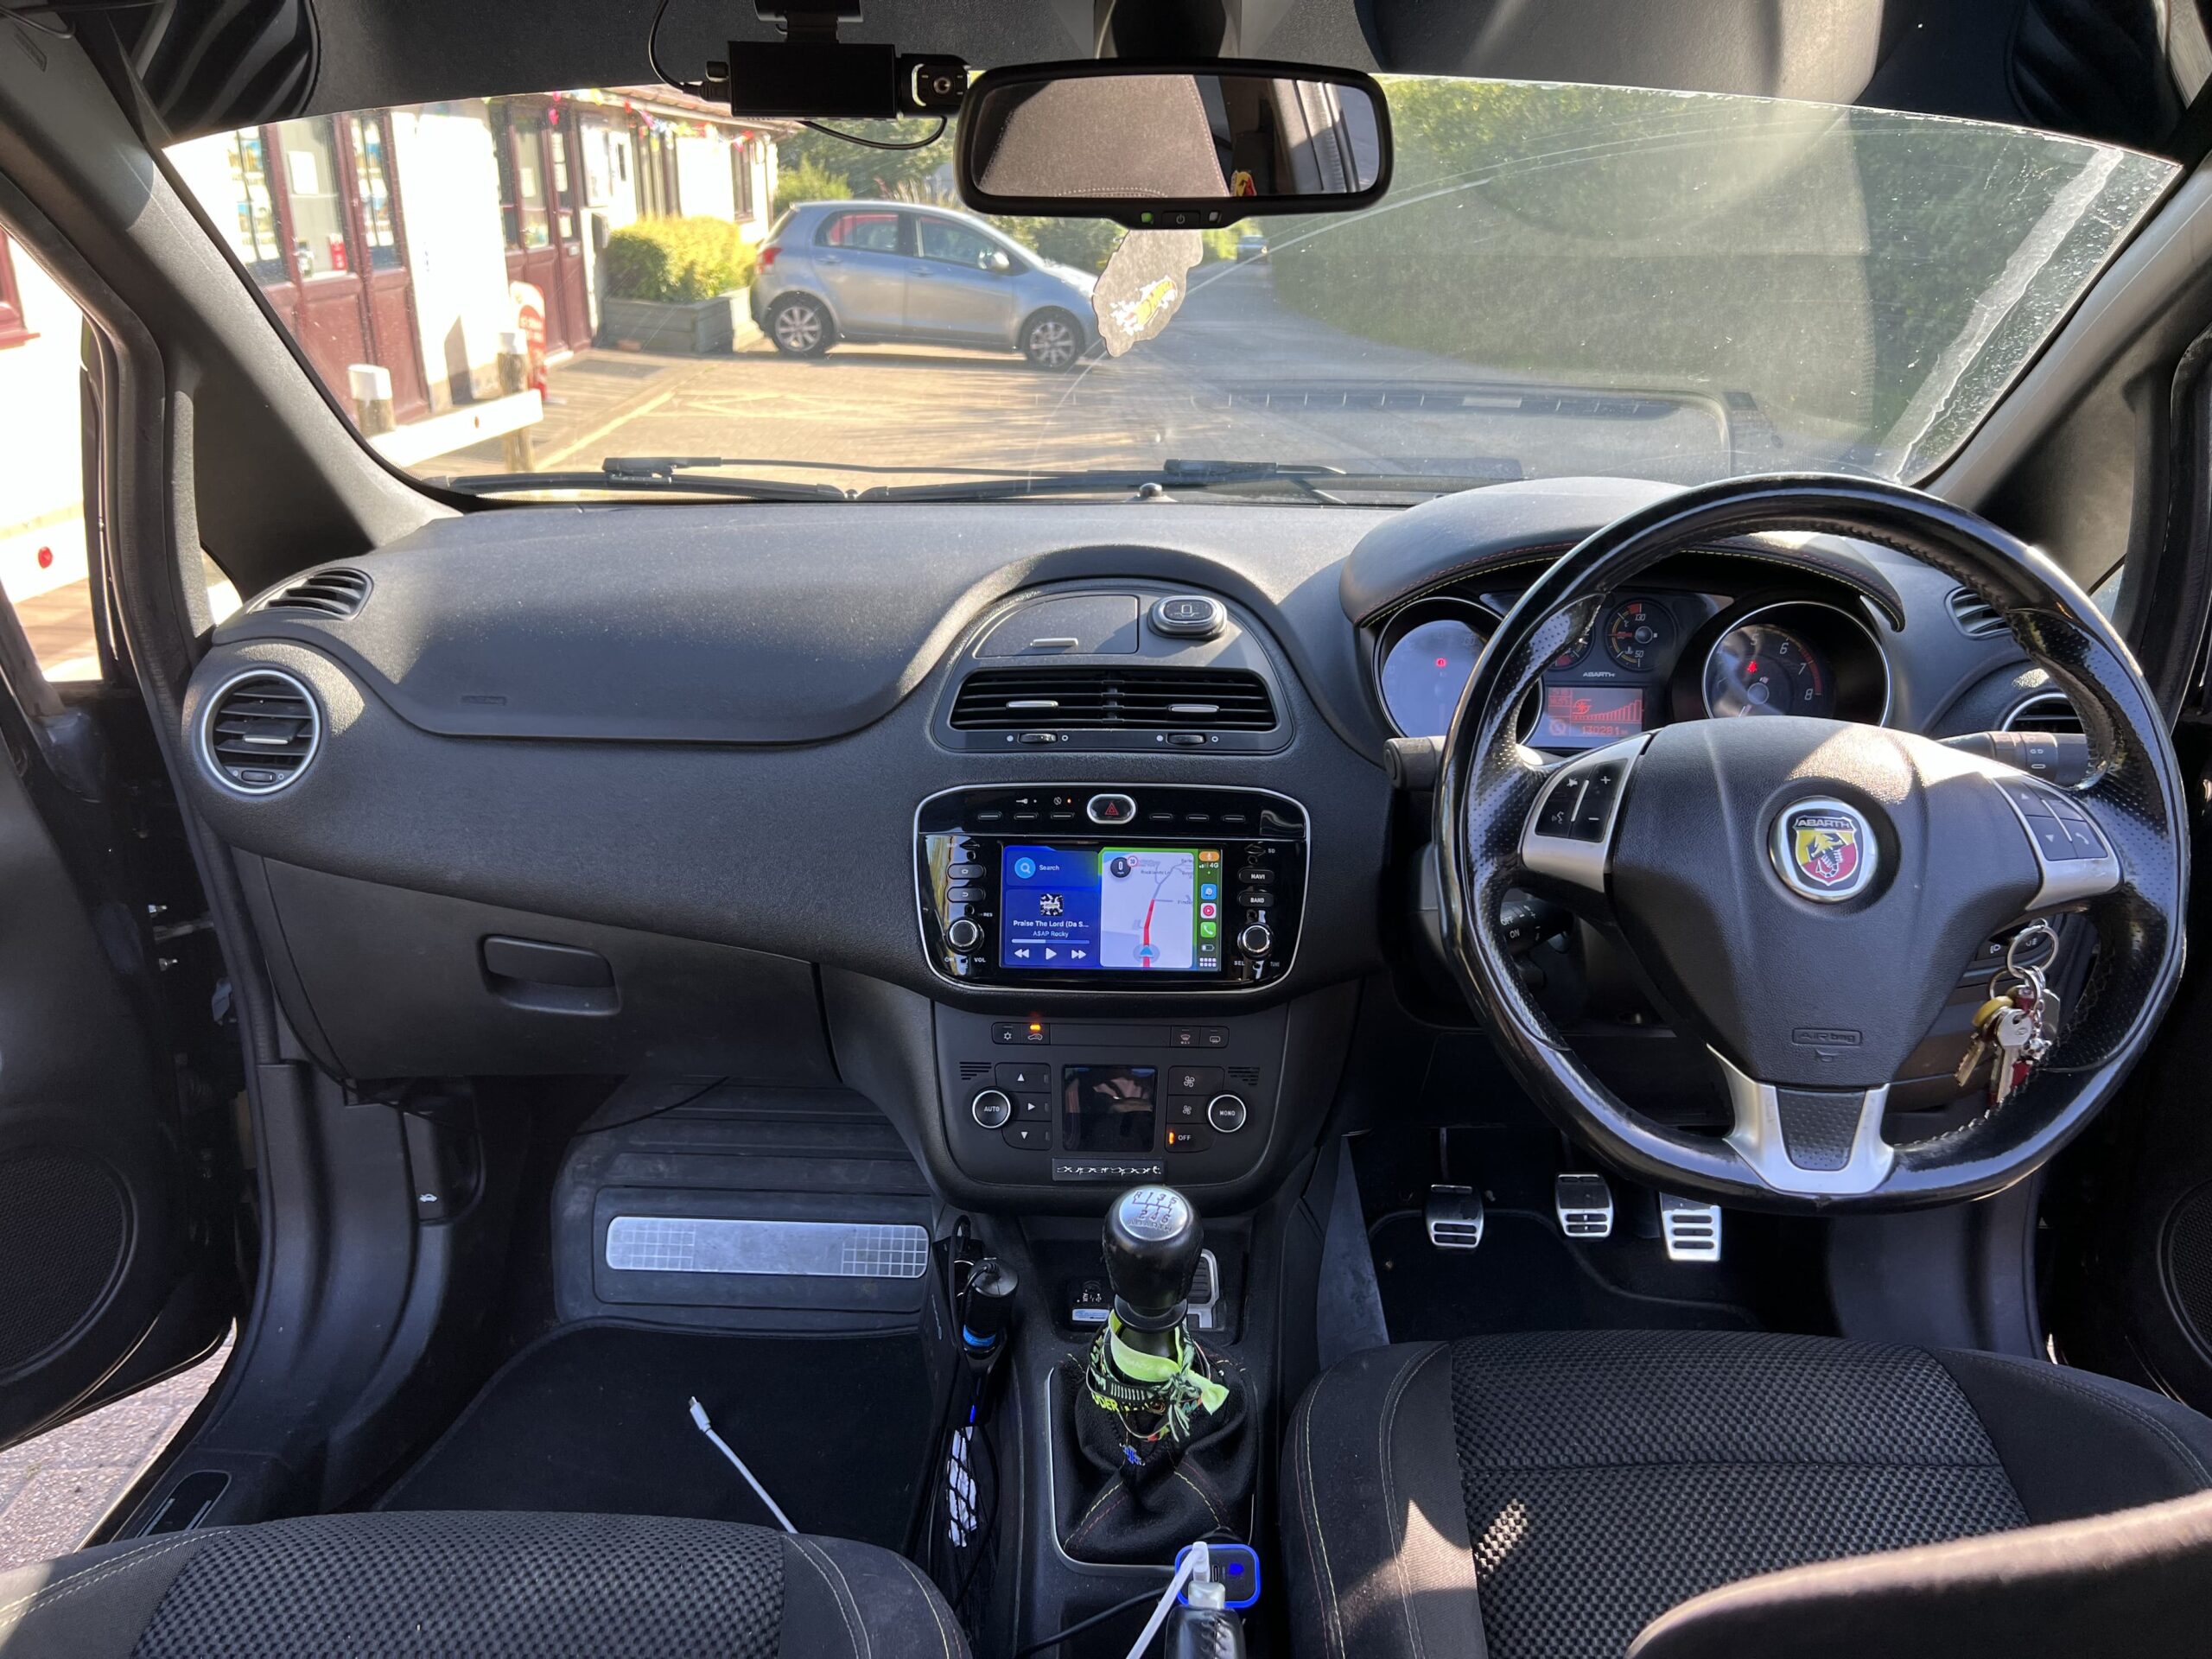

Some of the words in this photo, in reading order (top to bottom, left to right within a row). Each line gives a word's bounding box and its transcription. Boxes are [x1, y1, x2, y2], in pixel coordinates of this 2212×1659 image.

[1750, 633, 1759, 645] 5
[1779, 642, 1789, 655] 6
[1634, 650, 1644, 658] 50
[1797, 663, 1807, 676] 7
[1803, 688, 1814, 701] 8
[1797, 819, 1850, 829] ABARTH
[1065, 920, 1077, 929] (Da
[1500, 916, 1514, 926] OFF
[1509, 928, 1521, 939] ON
[1139, 1209, 1148, 1219] 2
